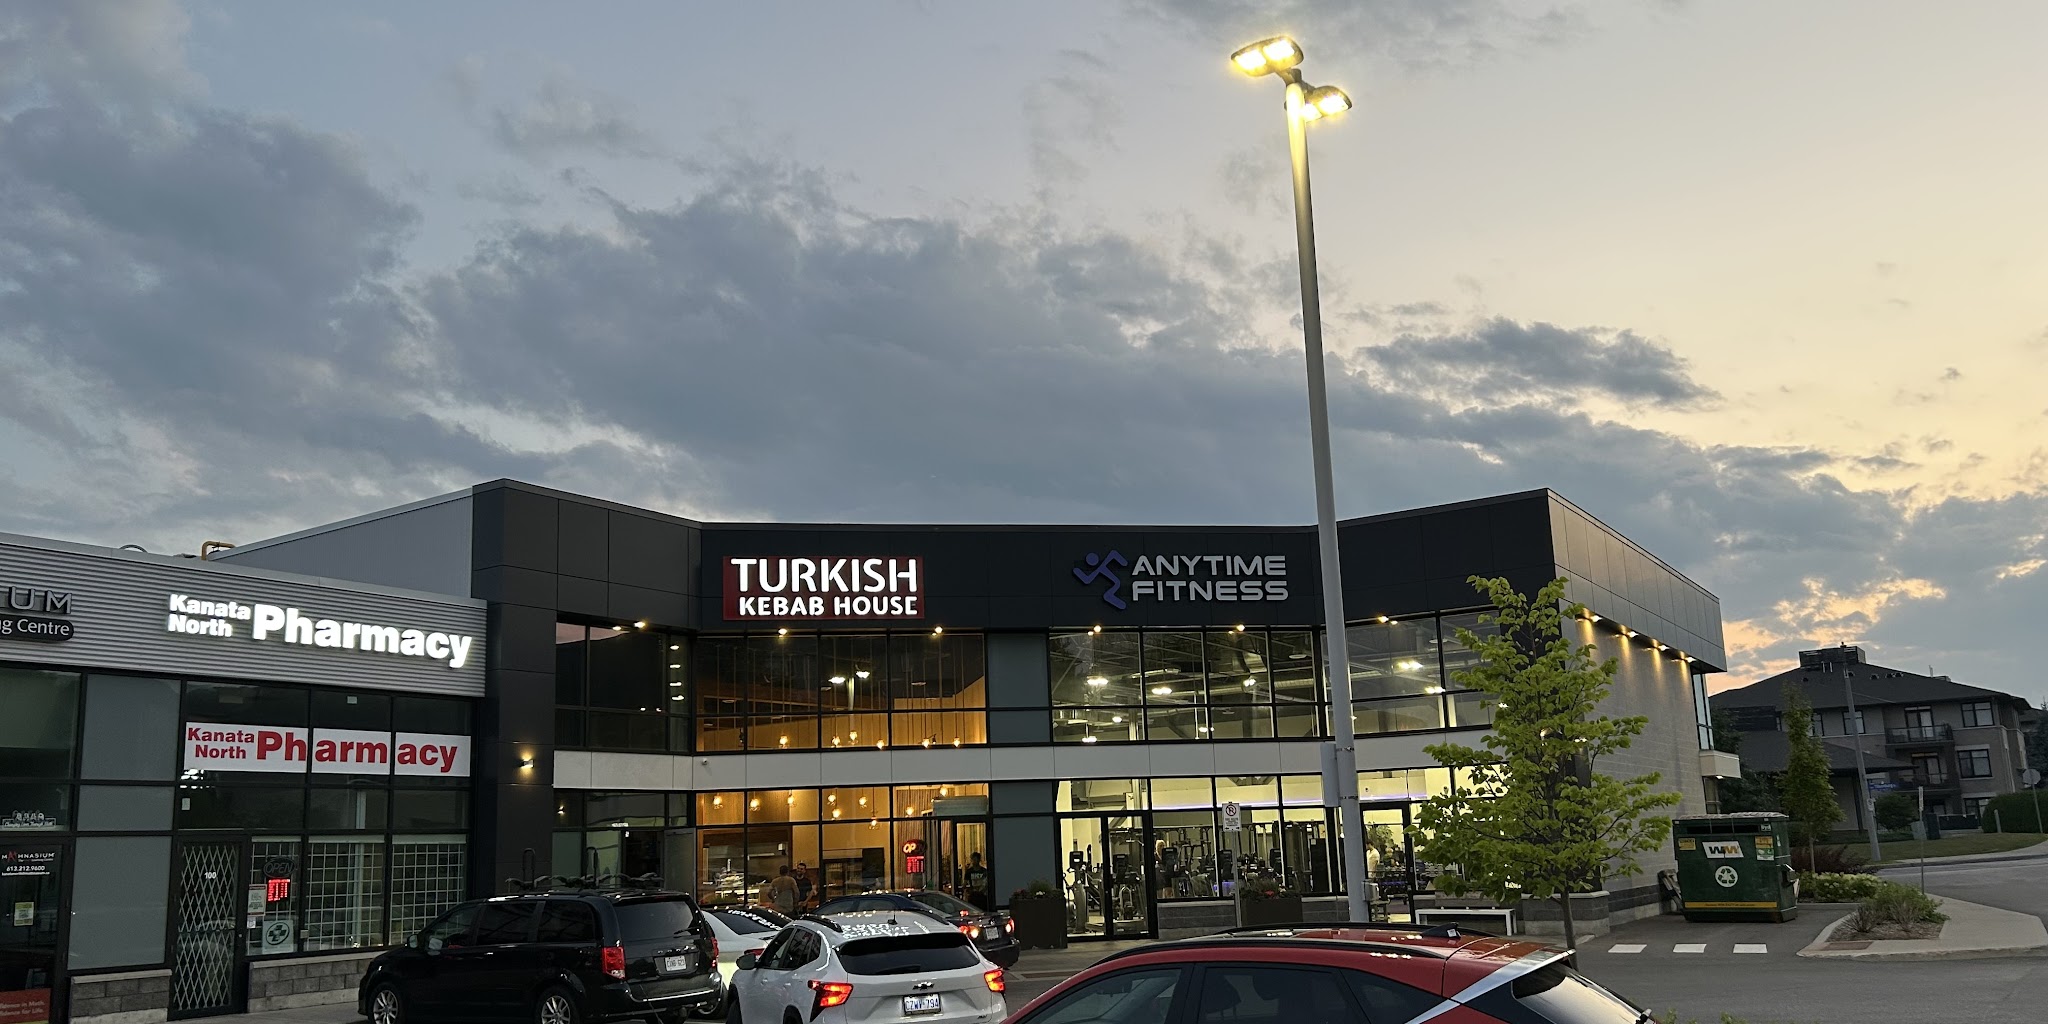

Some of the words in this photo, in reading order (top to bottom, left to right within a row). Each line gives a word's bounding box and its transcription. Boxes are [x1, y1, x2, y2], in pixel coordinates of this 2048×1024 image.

[731, 558, 918, 592] TURKISH
[1131, 555, 1287, 576] ANYTIME
[1132, 580, 1289, 601] FITNESS
[168, 593, 251, 620] Kanata
[739, 597, 825, 616] KEBAB
[834, 596, 918, 616] HOUSE
[17, 618, 70, 636] Centre
[167, 613, 233, 637] North
[251, 603, 473, 669] Pharmacy
[187, 727, 255, 743] Kanata
[194, 744, 247, 759] North
[256, 730, 458, 773] Pharmacy
[1708, 846, 1740, 855] WM
[204, 871, 217, 880] 100
[266, 862, 294, 874] OPEN
